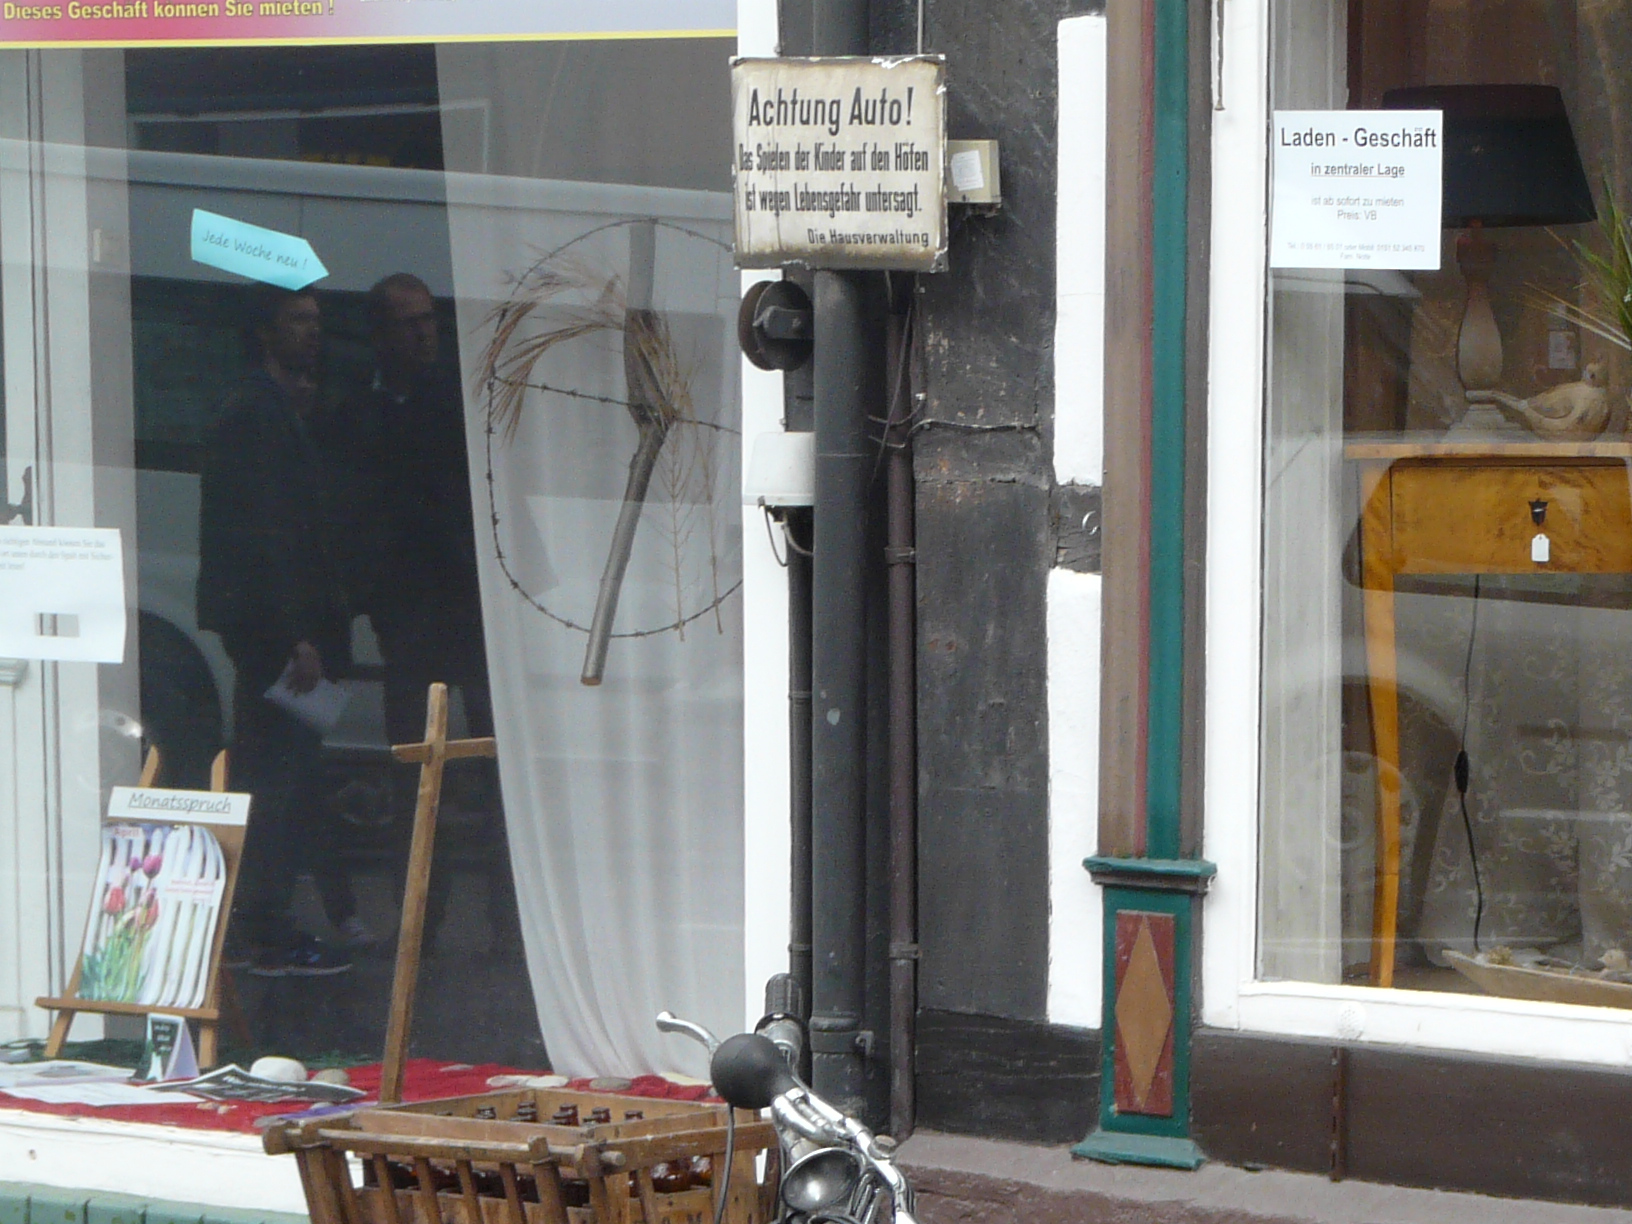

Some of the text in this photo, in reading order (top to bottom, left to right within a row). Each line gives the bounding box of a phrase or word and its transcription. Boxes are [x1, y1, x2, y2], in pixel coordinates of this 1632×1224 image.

[4, 2, 62, 19] Dieses
[225, 0, 253, 16] Sie
[259, 0, 322, 15] mieten
[748, 86, 913, 136] Achtung Auto!
[1281, 127, 1336, 147] Laden
[1354, 127, 1437, 148] Geschäft
[739, 142, 929, 174] Das Spielen der Kinder auf den Höfen
[1311, 163, 1405, 178] in zentraler Lage
[745, 183, 923, 218] ist wegen Lebensgefahr untersagt.
[1323, 196, 1334, 206] ab
[1336, 196, 1360, 206] sofort
[1362, 198, 1373, 206] zu
[1375, 197, 1404, 207] mieten
[1364, 210, 1377, 220] VB
[807, 228, 930, 247] Die Hausverwaltung
[202, 230, 229, 248] Jede
[234, 238, 272, 260] Woche
[276, 254, 298, 267] neu
[128, 791, 231, 812] Monatsspruch
